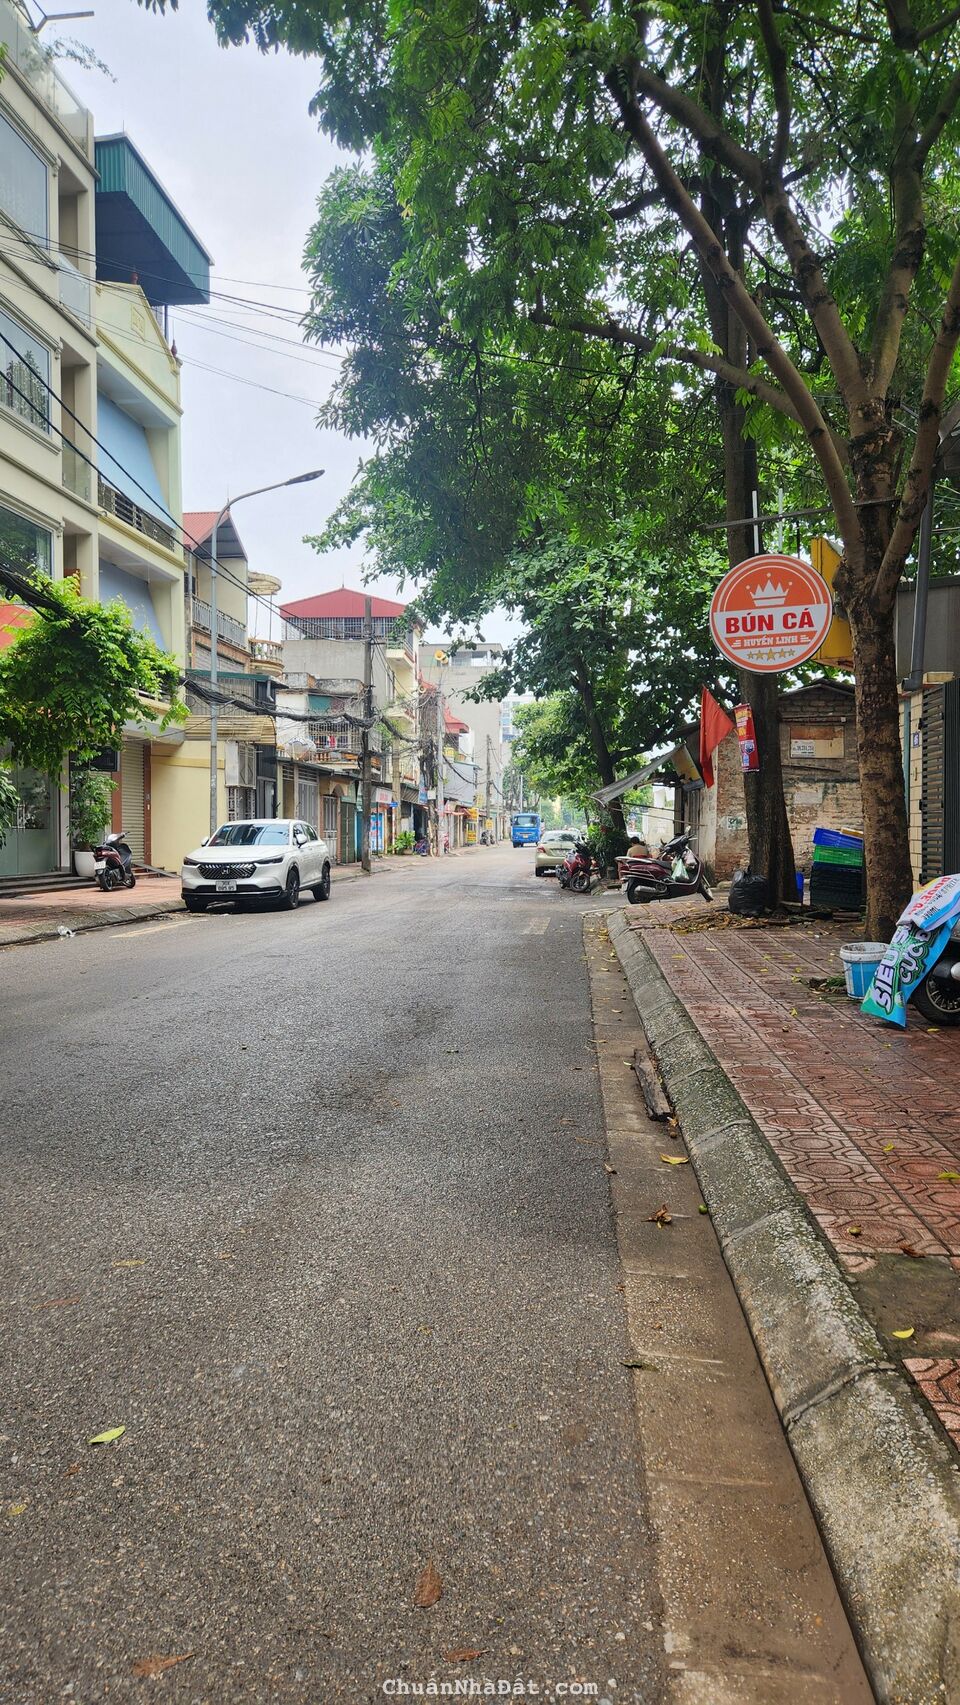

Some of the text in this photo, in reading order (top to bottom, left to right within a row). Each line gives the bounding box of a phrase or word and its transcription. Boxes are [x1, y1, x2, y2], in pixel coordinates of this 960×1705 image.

[726, 608, 814, 634] BÚN CÁ
[776, 635, 798, 645] LINH
